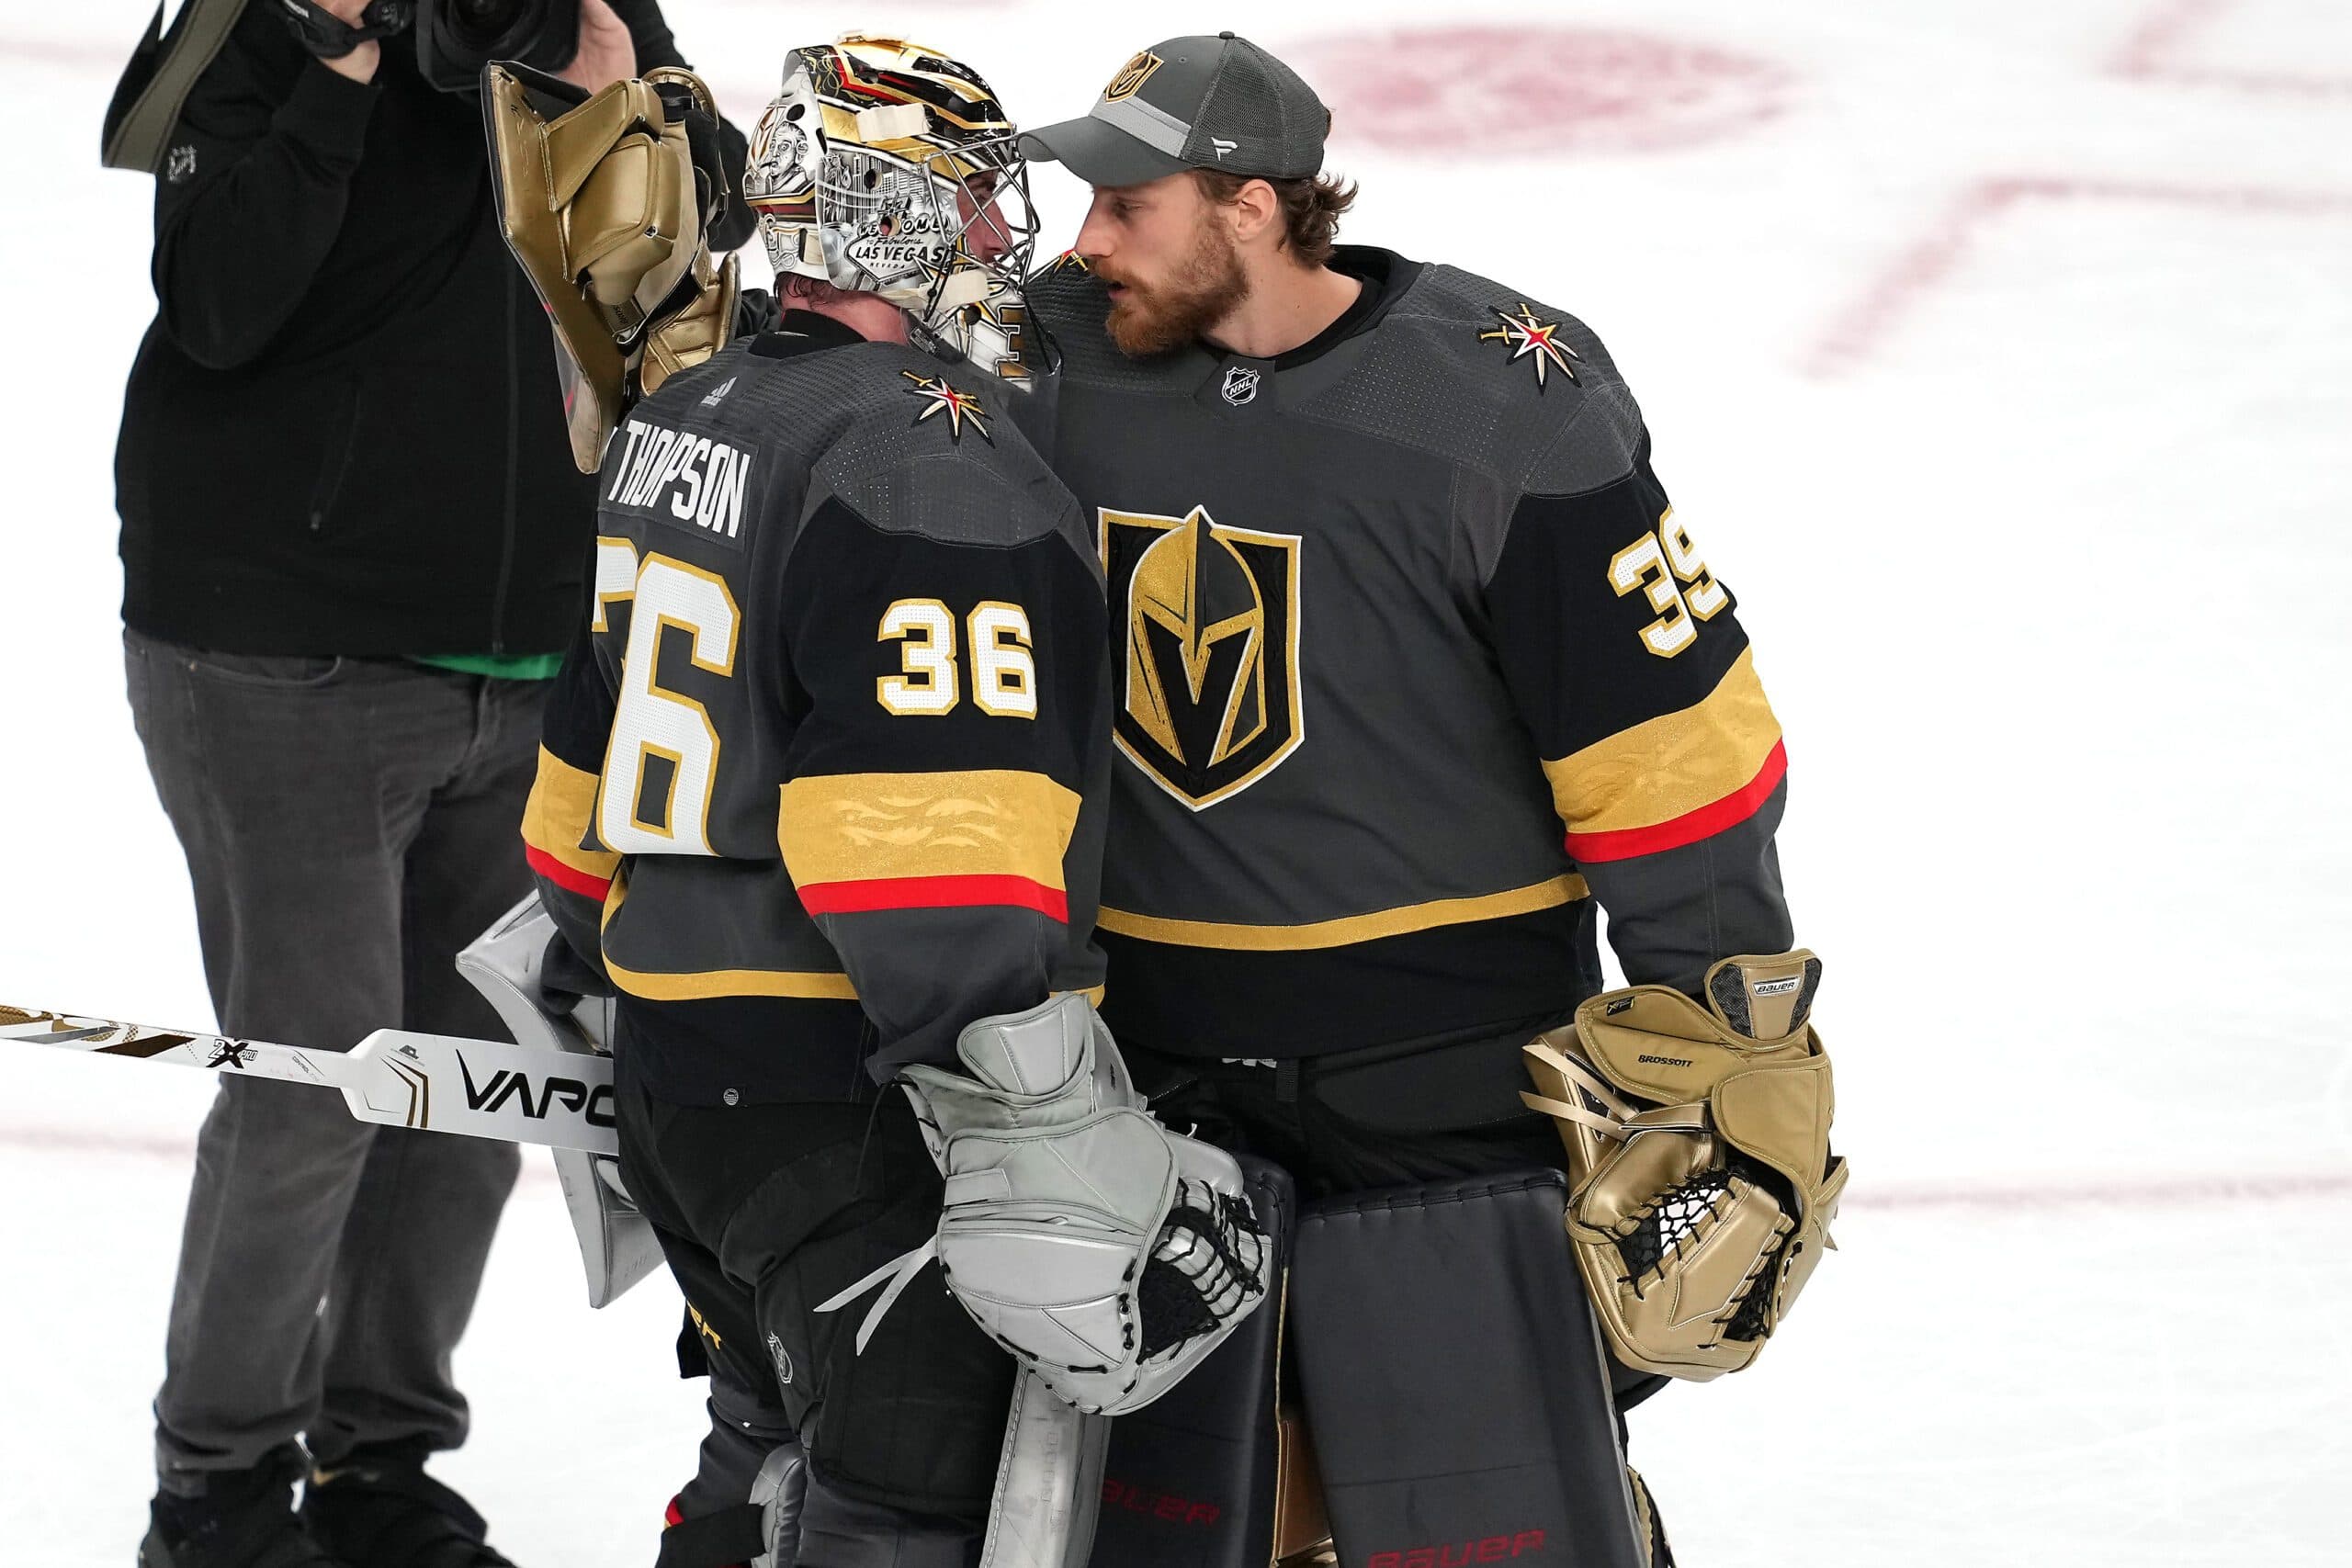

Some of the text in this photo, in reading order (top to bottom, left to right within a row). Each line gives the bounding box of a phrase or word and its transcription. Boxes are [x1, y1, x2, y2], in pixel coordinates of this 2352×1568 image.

[859, 218, 948, 235] WEOME
[855, 246, 945, 263] LAS VEGAS
[1229, 379, 1251, 395] NHL
[1607, 503, 1729, 659] 39
[876, 598, 1038, 720] 36
[456, 1048, 616, 1128] VAPO
